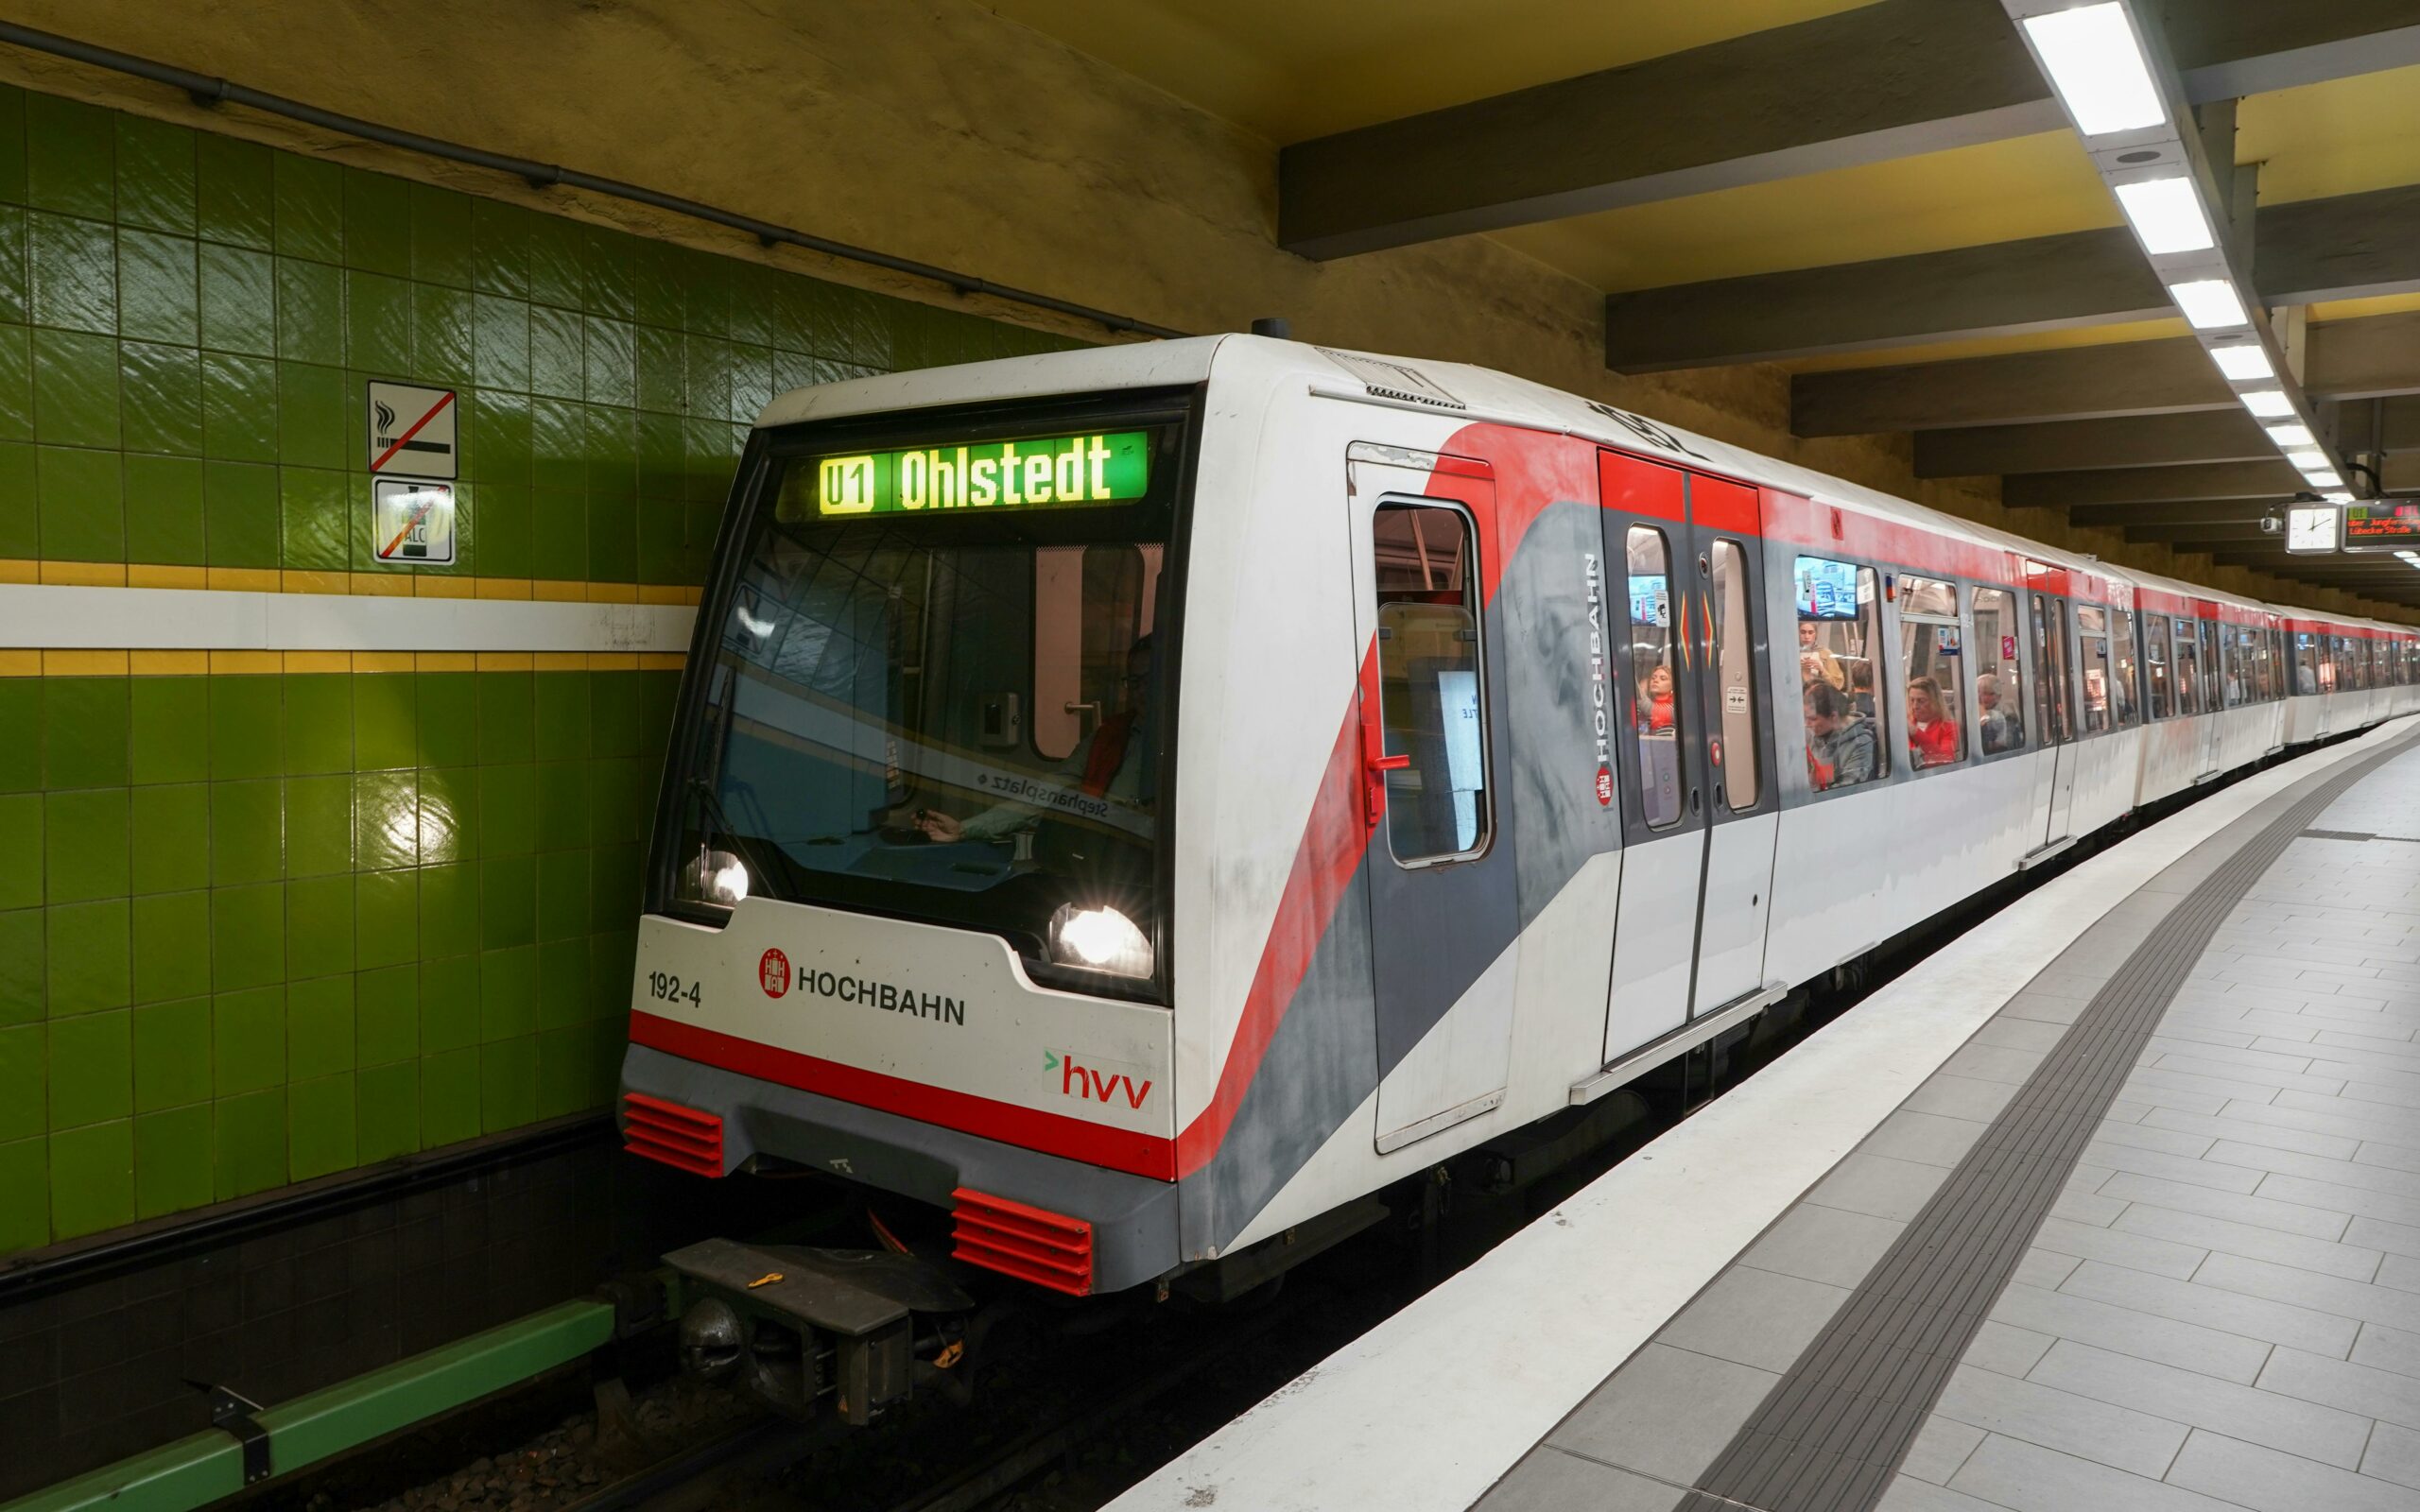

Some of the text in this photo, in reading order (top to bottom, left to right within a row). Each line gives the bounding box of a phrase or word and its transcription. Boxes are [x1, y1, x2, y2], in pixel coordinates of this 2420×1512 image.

[828, 436, 1111, 509] U1 Ohlstedt
[1584, 553, 1608, 763] HOCHBAHN
[648, 974, 701, 1008] 192-4
[798, 967, 964, 1026] HOCHBAHN
[1063, 1055, 1152, 1109] hvv
